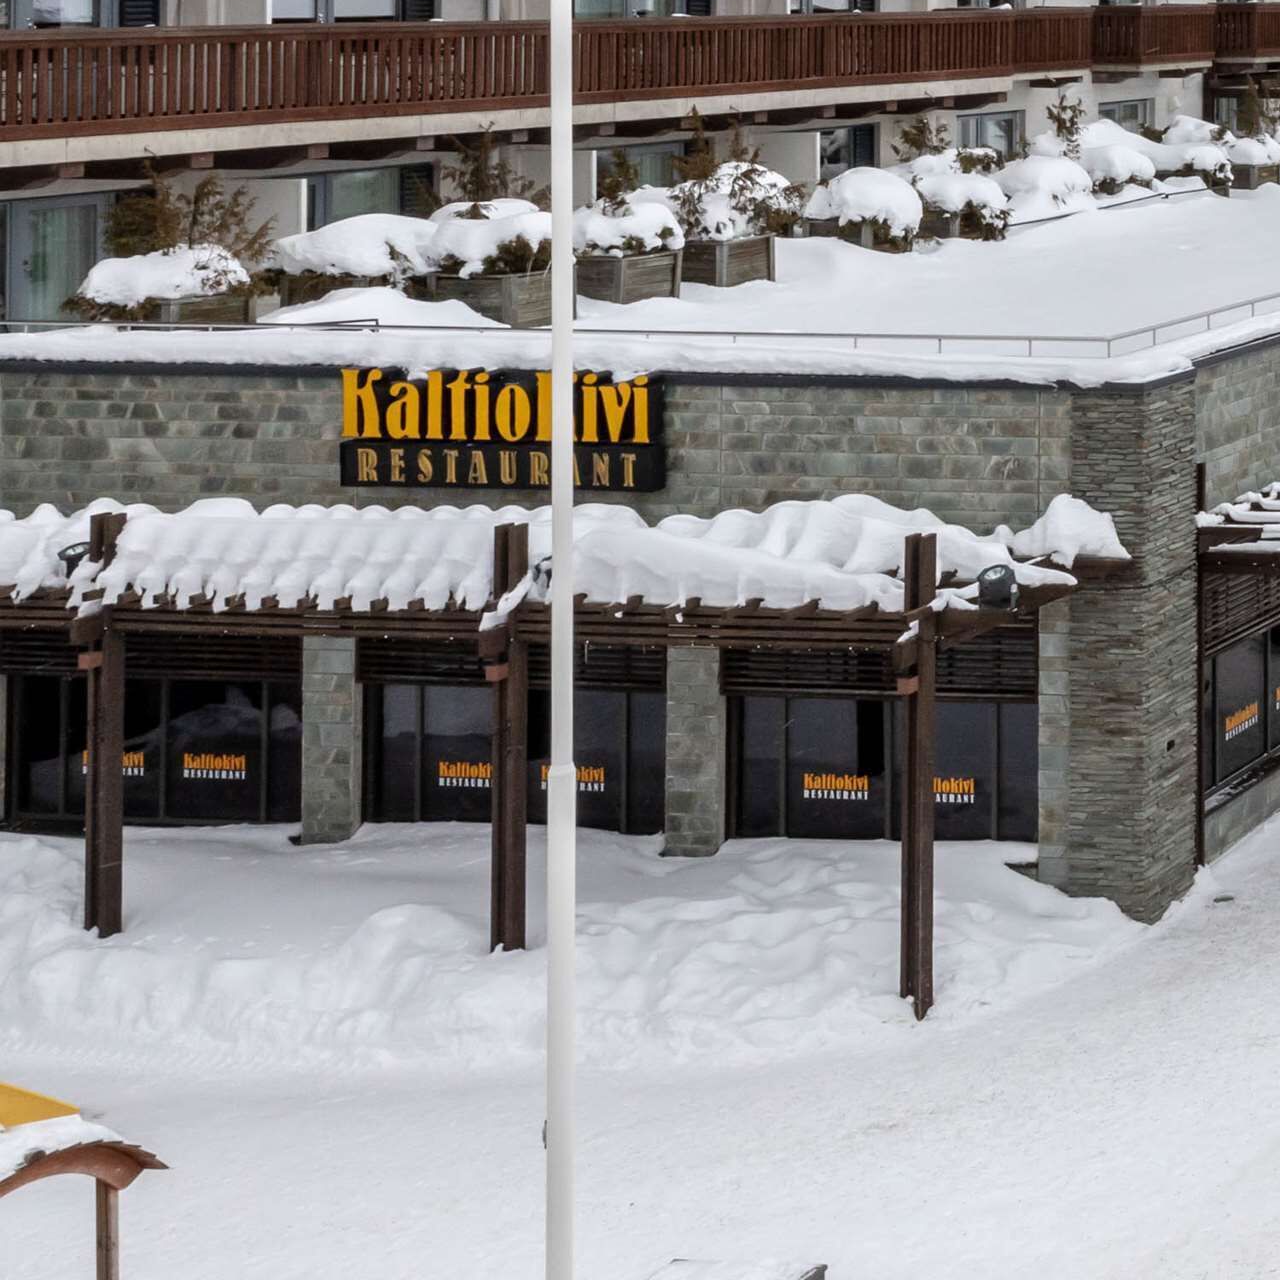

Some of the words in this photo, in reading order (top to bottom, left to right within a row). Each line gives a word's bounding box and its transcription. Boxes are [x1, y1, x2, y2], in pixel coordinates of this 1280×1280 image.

[439, 778, 490, 787] RESTAURA
[803, 789, 868, 800] RESTAURANT
[935, 793, 975, 804] AURANT
